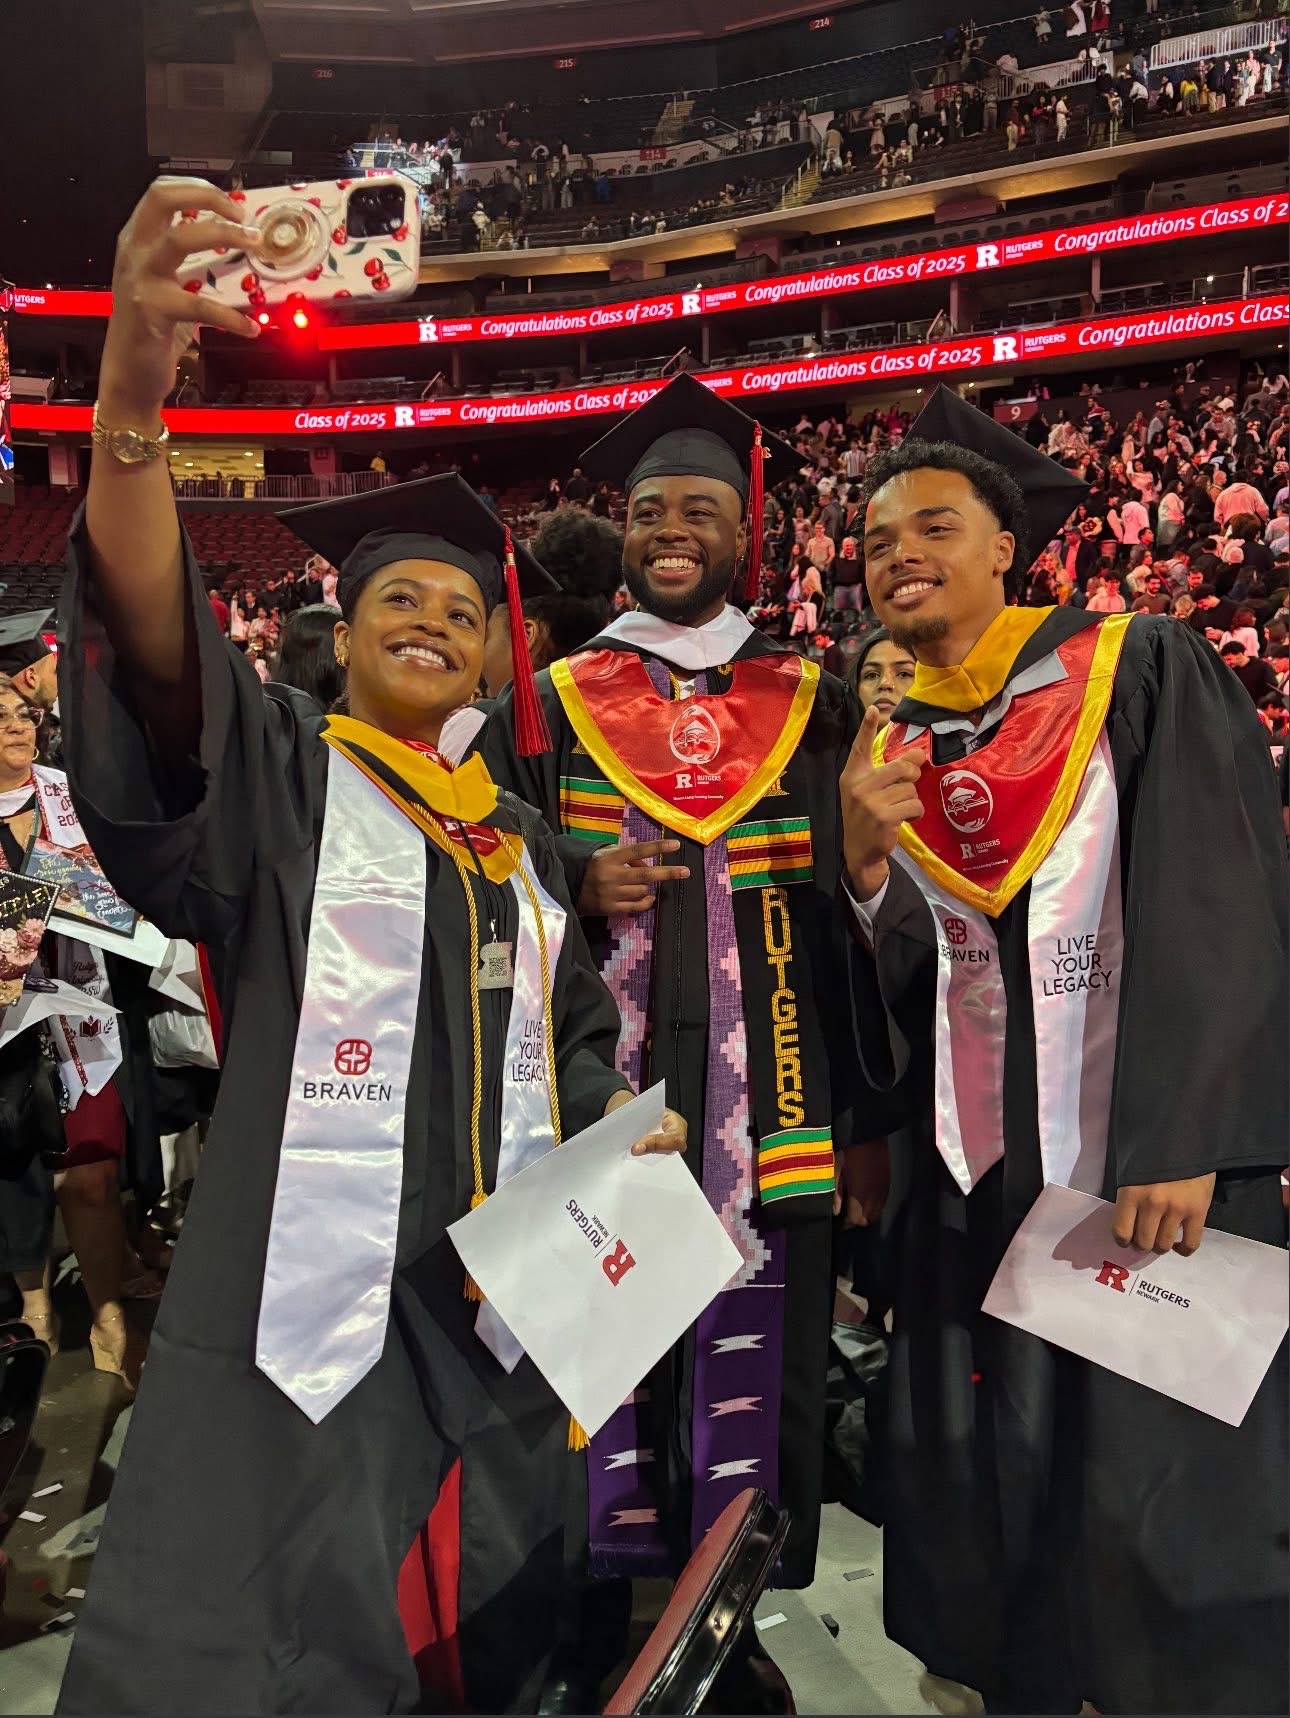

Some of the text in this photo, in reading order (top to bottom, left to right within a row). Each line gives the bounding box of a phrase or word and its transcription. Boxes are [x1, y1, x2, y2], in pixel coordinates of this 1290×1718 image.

[814, 18, 830, 28] 214
[559, 58, 574, 68] 215
[1054, 216, 1195, 253] Congratulations
[1199, 208, 1250, 229] Class
[1253, 200, 1276, 223] of
[975, 239, 1044, 269] R RUTGERS
[745, 253, 967, 303] Congratulations Class of 2025
[682, 293, 702, 315] R
[705, 290, 737, 302] RUTGERS
[480, 302, 674, 337] Congratulations Class of 2025
[1078, 303, 1289, 347] Congratulations Class
[419, 321, 438, 342] R
[992, 332, 1067, 362] R RUTGERS
[742, 346, 983, 391] Congratulations Class of 2025
[700, 378, 733, 389] UTGERS
[394, 406, 452, 427] R RUTGERS
[460, 388, 661, 423] Congratulations Class of 202
[1011, 406, 1021, 420] 9
[295, 411, 387, 431] Class of 2025
[675, 773, 693, 789] R
[960, 843, 976, 860] R
[975, 839, 1001, 850] RUTGERS
[1057, 934, 1096, 956] LIVE
[1051, 952, 1103, 975] YOUR
[1043, 970, 1113, 997] LEGACY
[761, 887, 806, 1128] RUTGERS
[524, 1019, 542, 1039] LIVE
[518, 1041, 544, 1061] YOUR
[303, 1082, 392, 1102] BRAVEN
[591, 1214, 610, 1239] NEWARK
[565, 1198, 637, 1288] R RUTGERS
[1095, 1260, 1191, 1308] R RUTGERS
[1135, 1289, 1161, 1304] NEWARK
